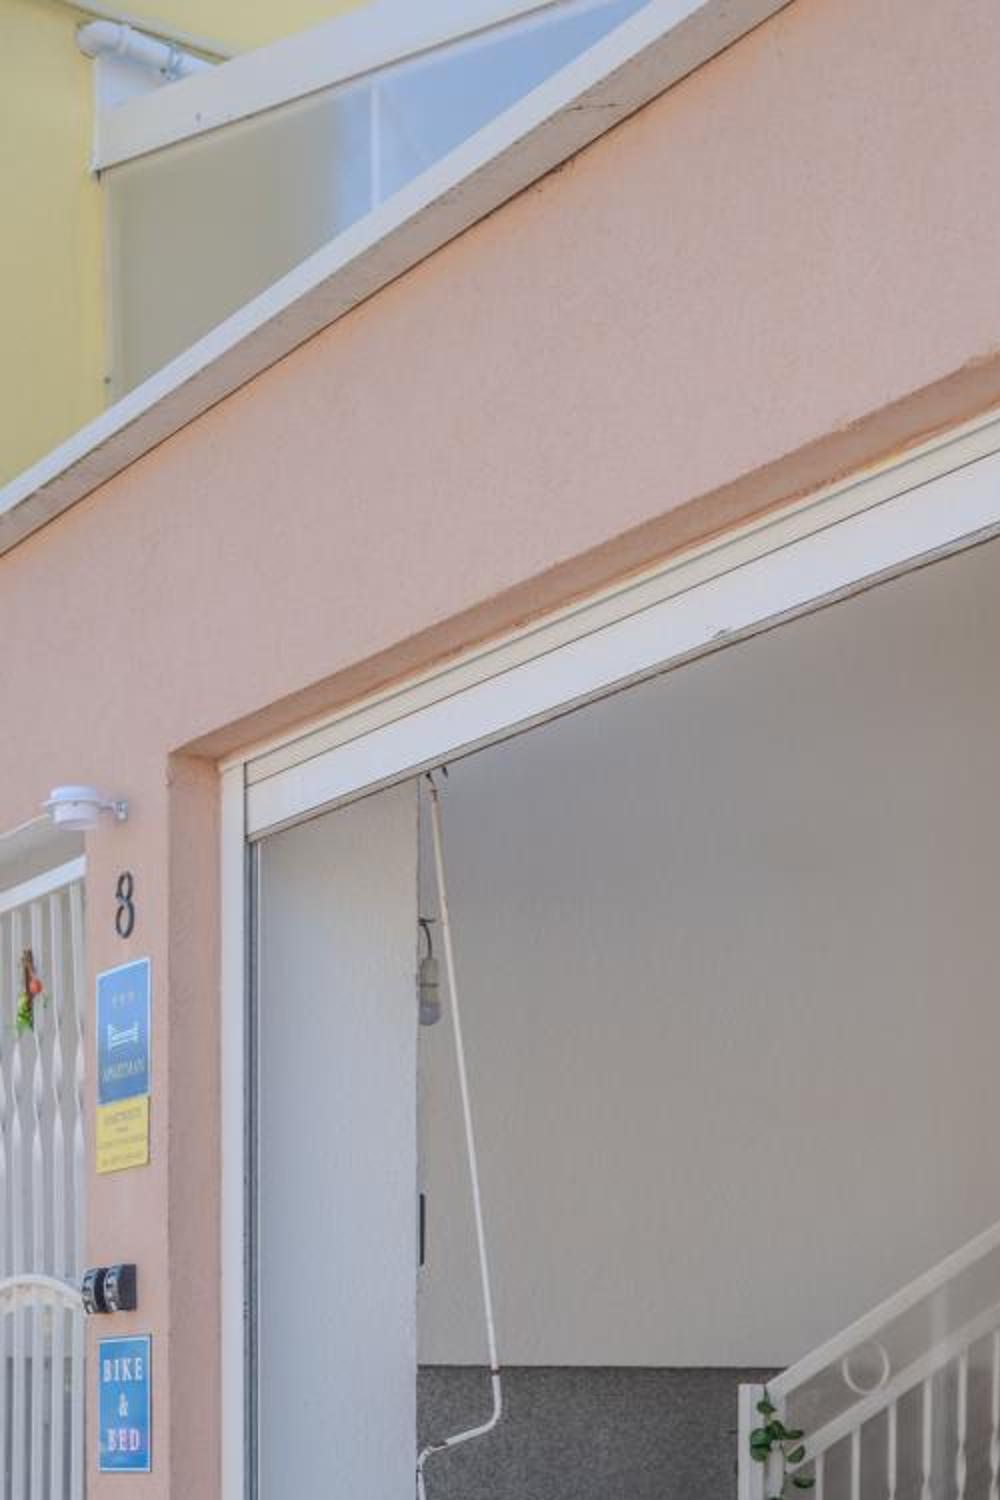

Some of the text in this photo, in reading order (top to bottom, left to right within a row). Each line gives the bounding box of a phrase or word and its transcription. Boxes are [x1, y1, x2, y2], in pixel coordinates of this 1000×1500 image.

[115, 871, 135, 939] 8
[103, 1357, 143, 1382] BIKE
[118, 1392, 129, 1417] &
[107, 1427, 140, 1451] BED
